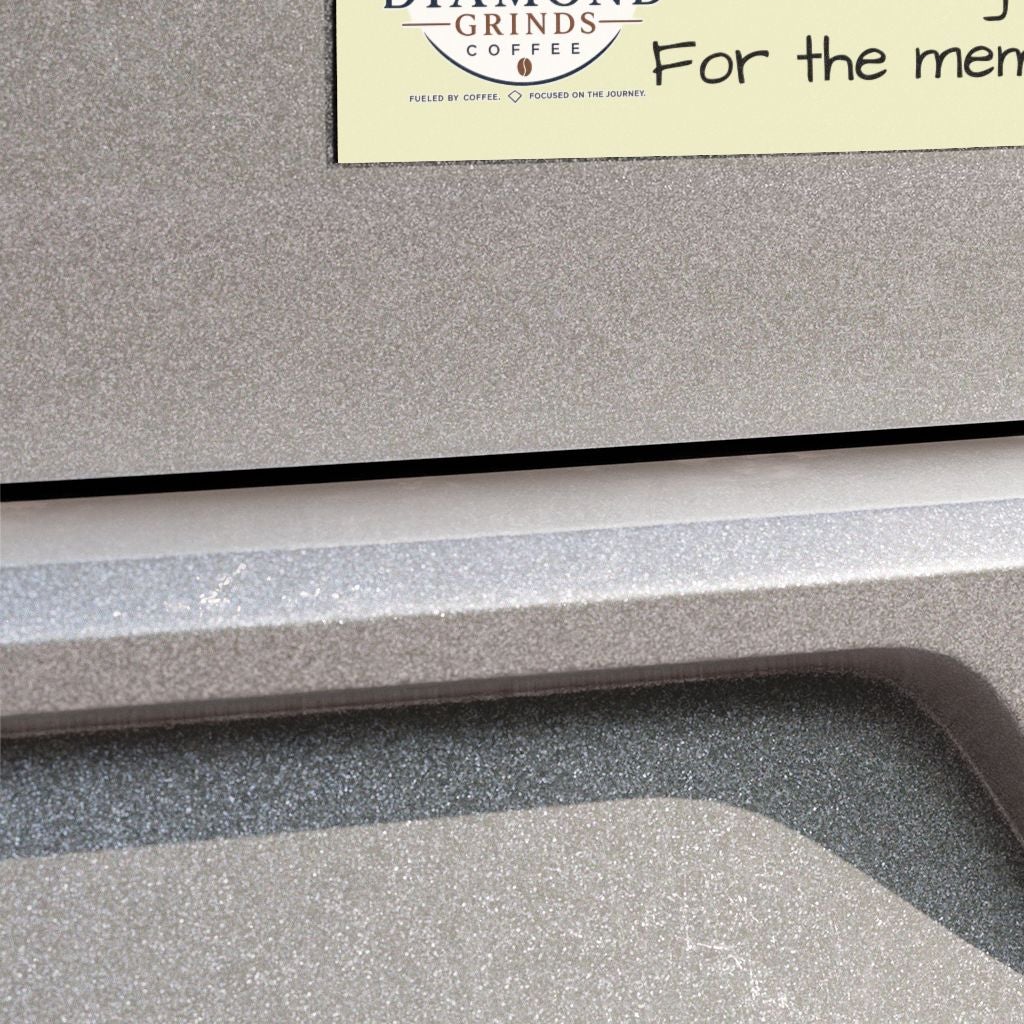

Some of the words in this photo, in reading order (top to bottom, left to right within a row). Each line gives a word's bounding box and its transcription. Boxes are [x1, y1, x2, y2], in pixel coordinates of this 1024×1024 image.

[455, 11, 596, 36] GRINDS
[467, 42, 580, 56] COFFEE
[652, 40, 769, 85] For
[797, 35, 887, 82] the
[529, 92, 569, 100] FOCUSED
[606, 89, 646, 98] JOURNEY.
